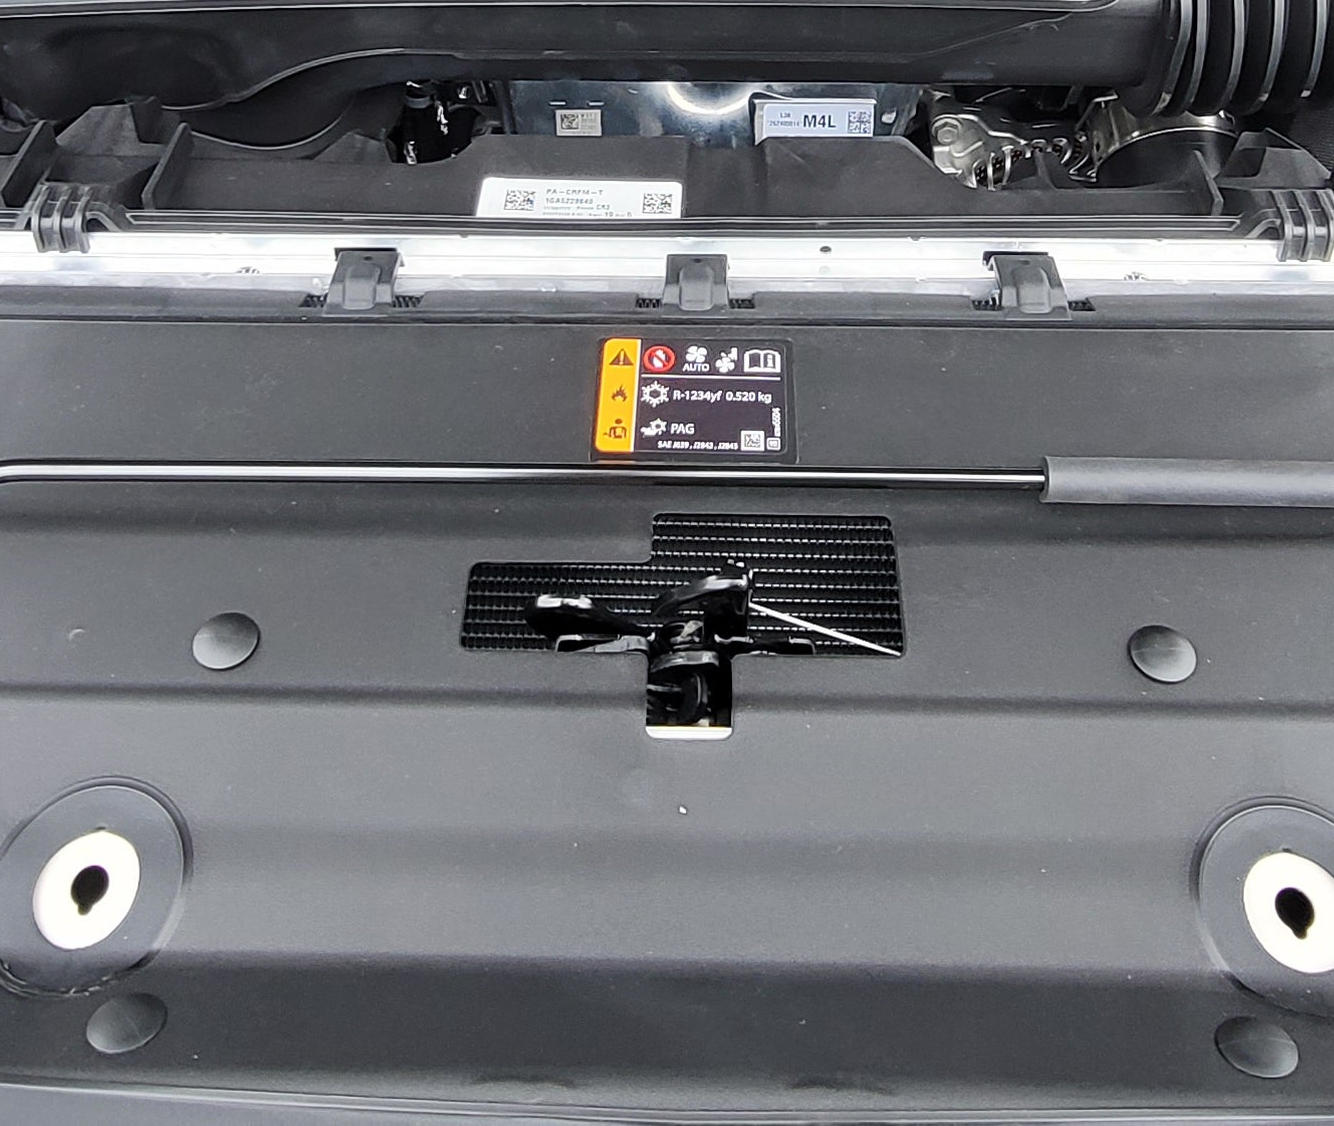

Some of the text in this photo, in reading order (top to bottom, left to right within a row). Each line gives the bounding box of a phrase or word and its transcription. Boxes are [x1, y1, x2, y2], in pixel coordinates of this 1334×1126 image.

[803, 114, 836, 128] M4L
[683, 362, 710, 372] AUTO
[673, 390, 772, 405] R-1234yf 0.520 kg
[670, 423, 695, 435] PAG
[657, 440, 672, 449] SAE
